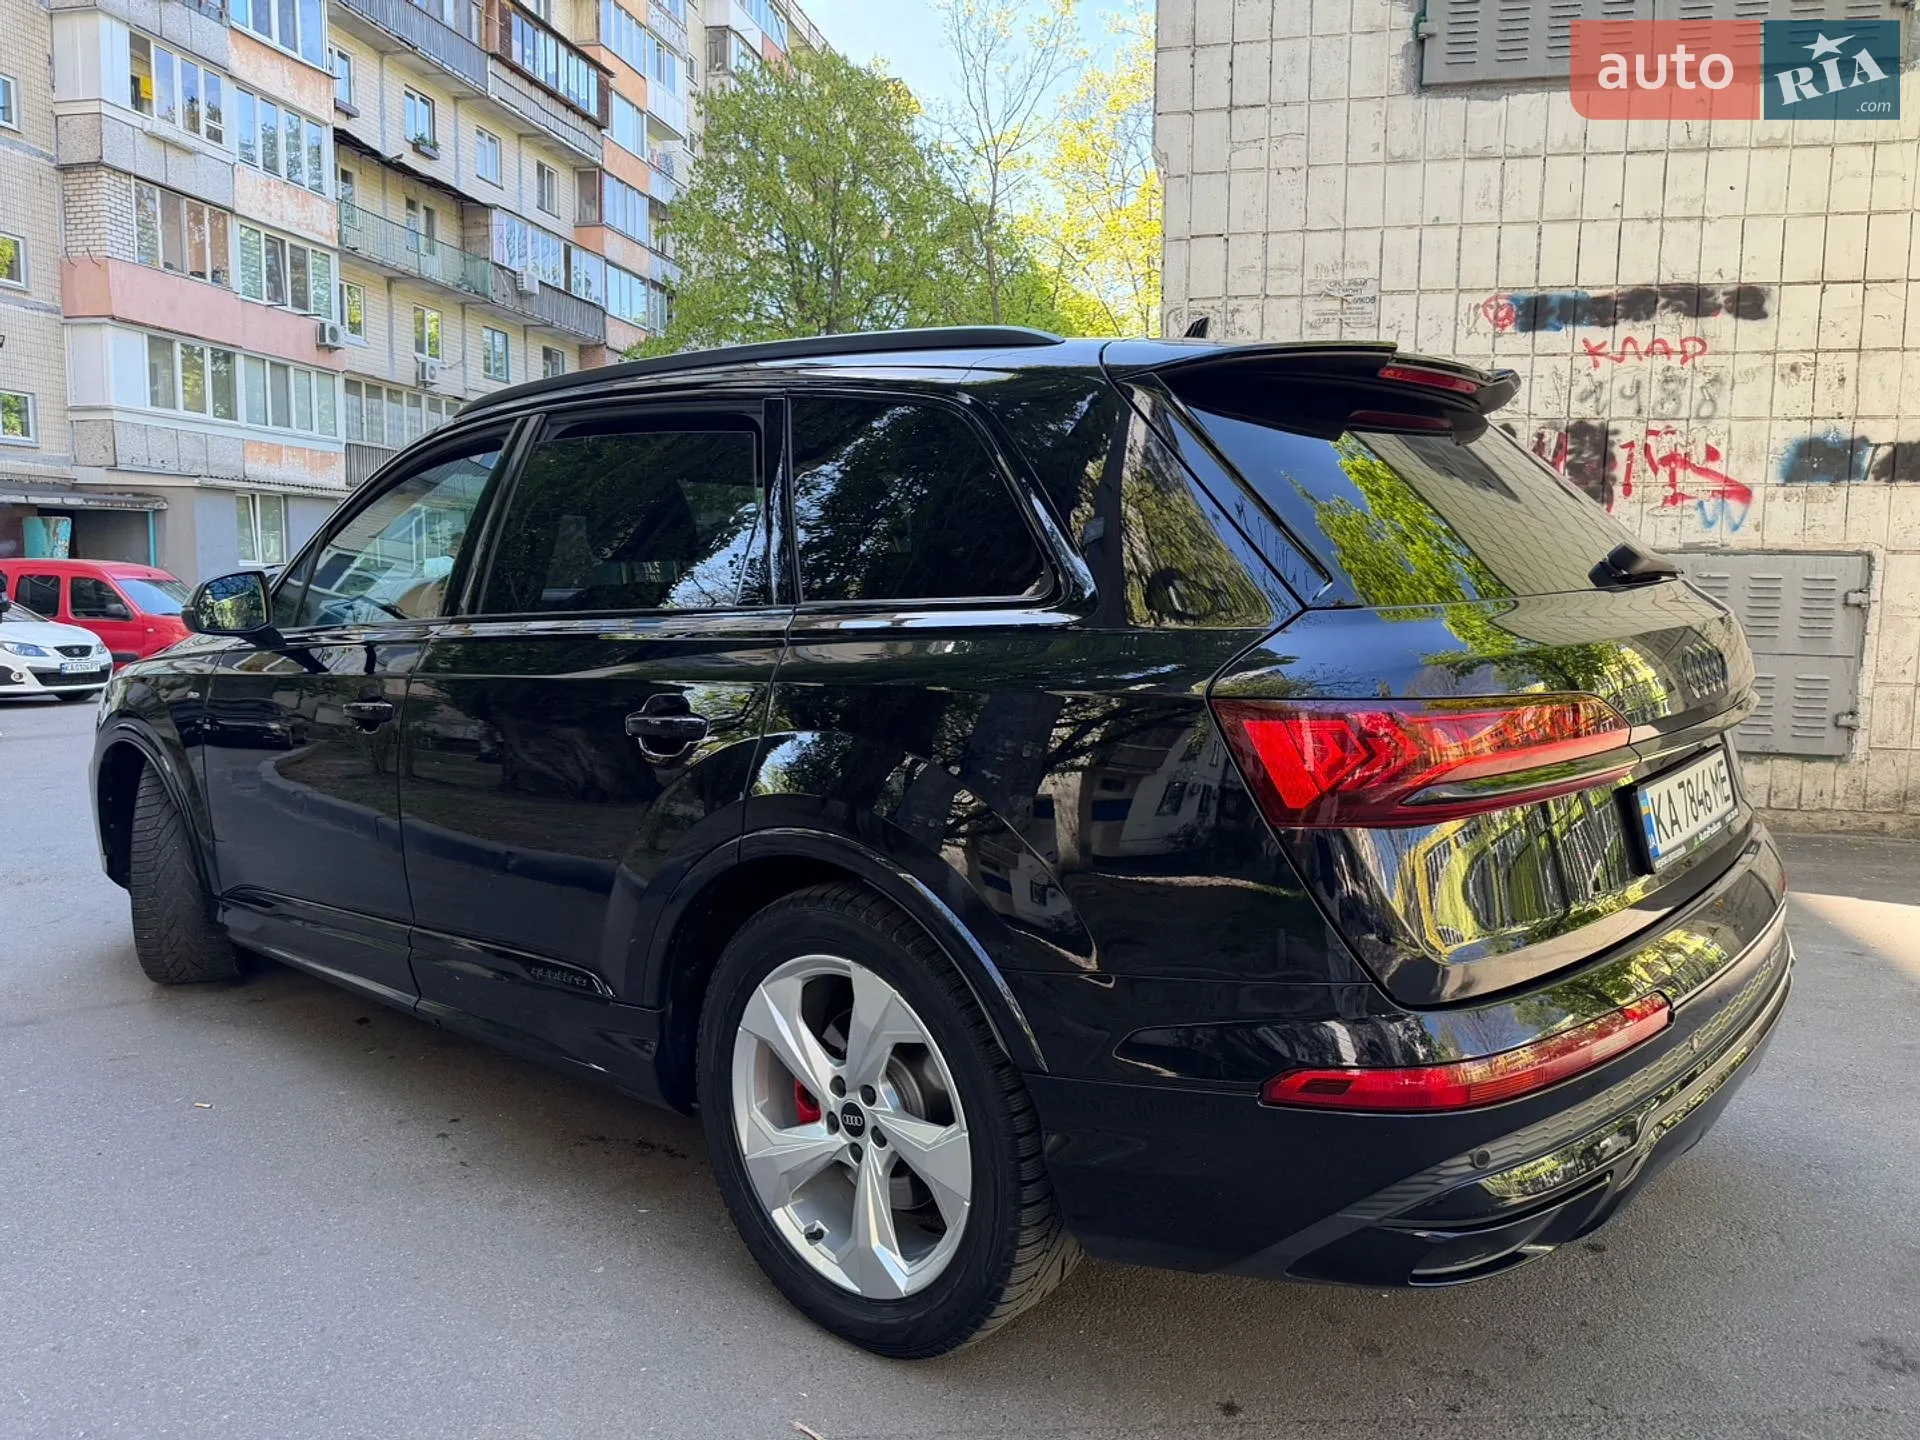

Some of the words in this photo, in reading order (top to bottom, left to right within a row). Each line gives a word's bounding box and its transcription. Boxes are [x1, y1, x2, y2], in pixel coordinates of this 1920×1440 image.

[1651, 789, 1683, 844] KA
[1677, 769, 1712, 828] 7846
[1709, 760, 1731, 808] ME
